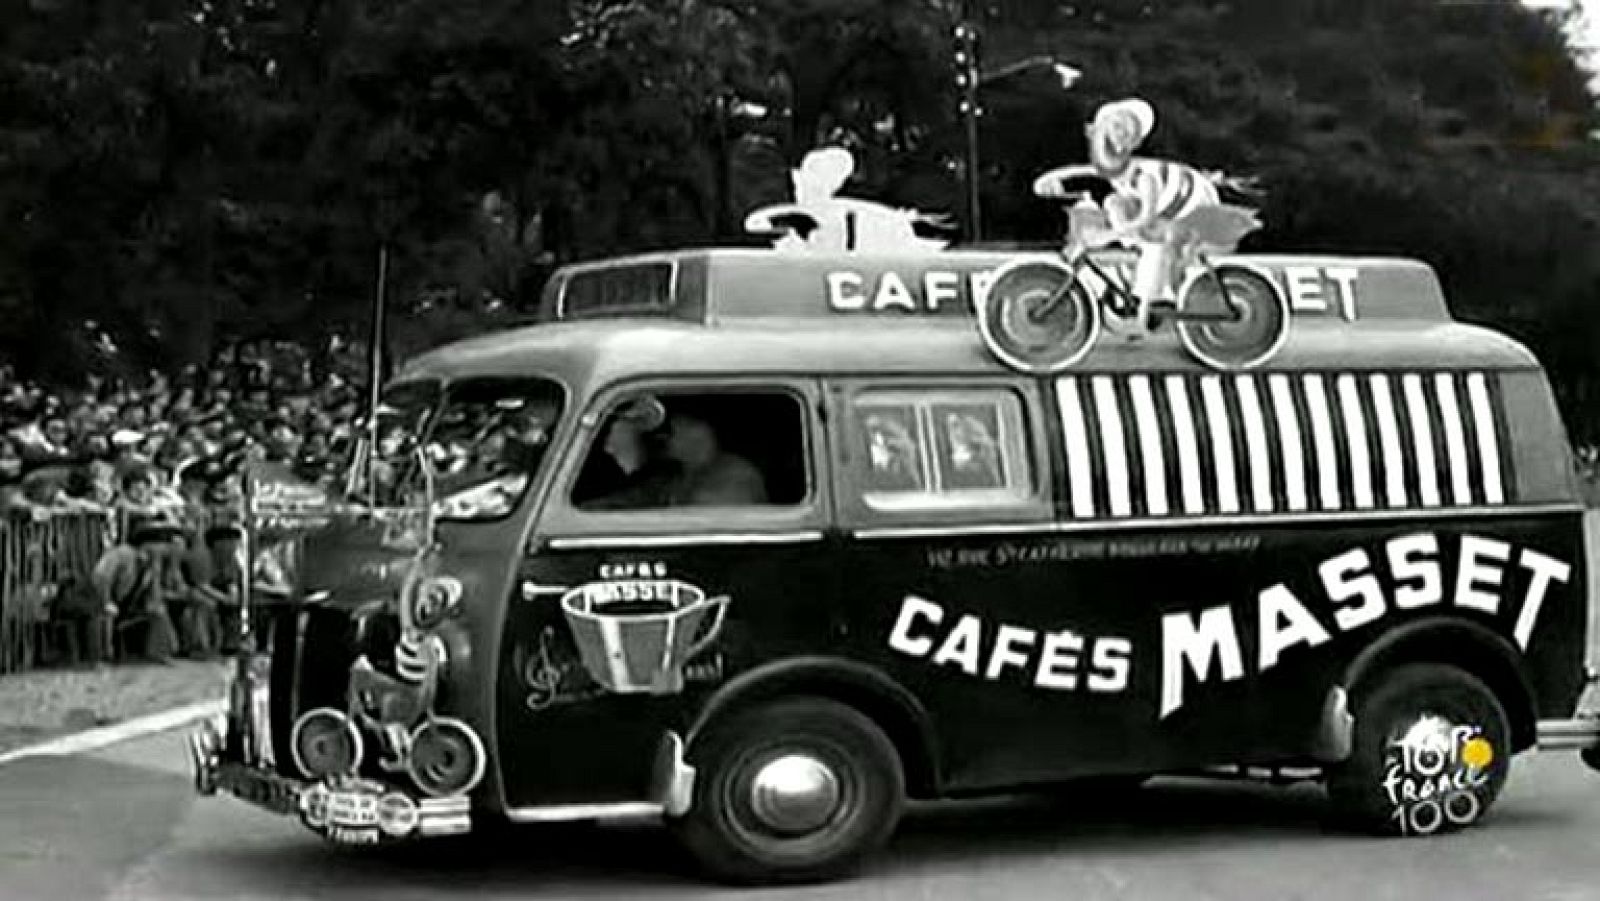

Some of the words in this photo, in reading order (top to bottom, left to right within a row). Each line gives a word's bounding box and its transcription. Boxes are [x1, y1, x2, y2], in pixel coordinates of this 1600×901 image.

[827, 271, 996, 316] CAF
[888, 595, 1133, 692] CAFÉS
[1160, 533, 1572, 719] MASSET
